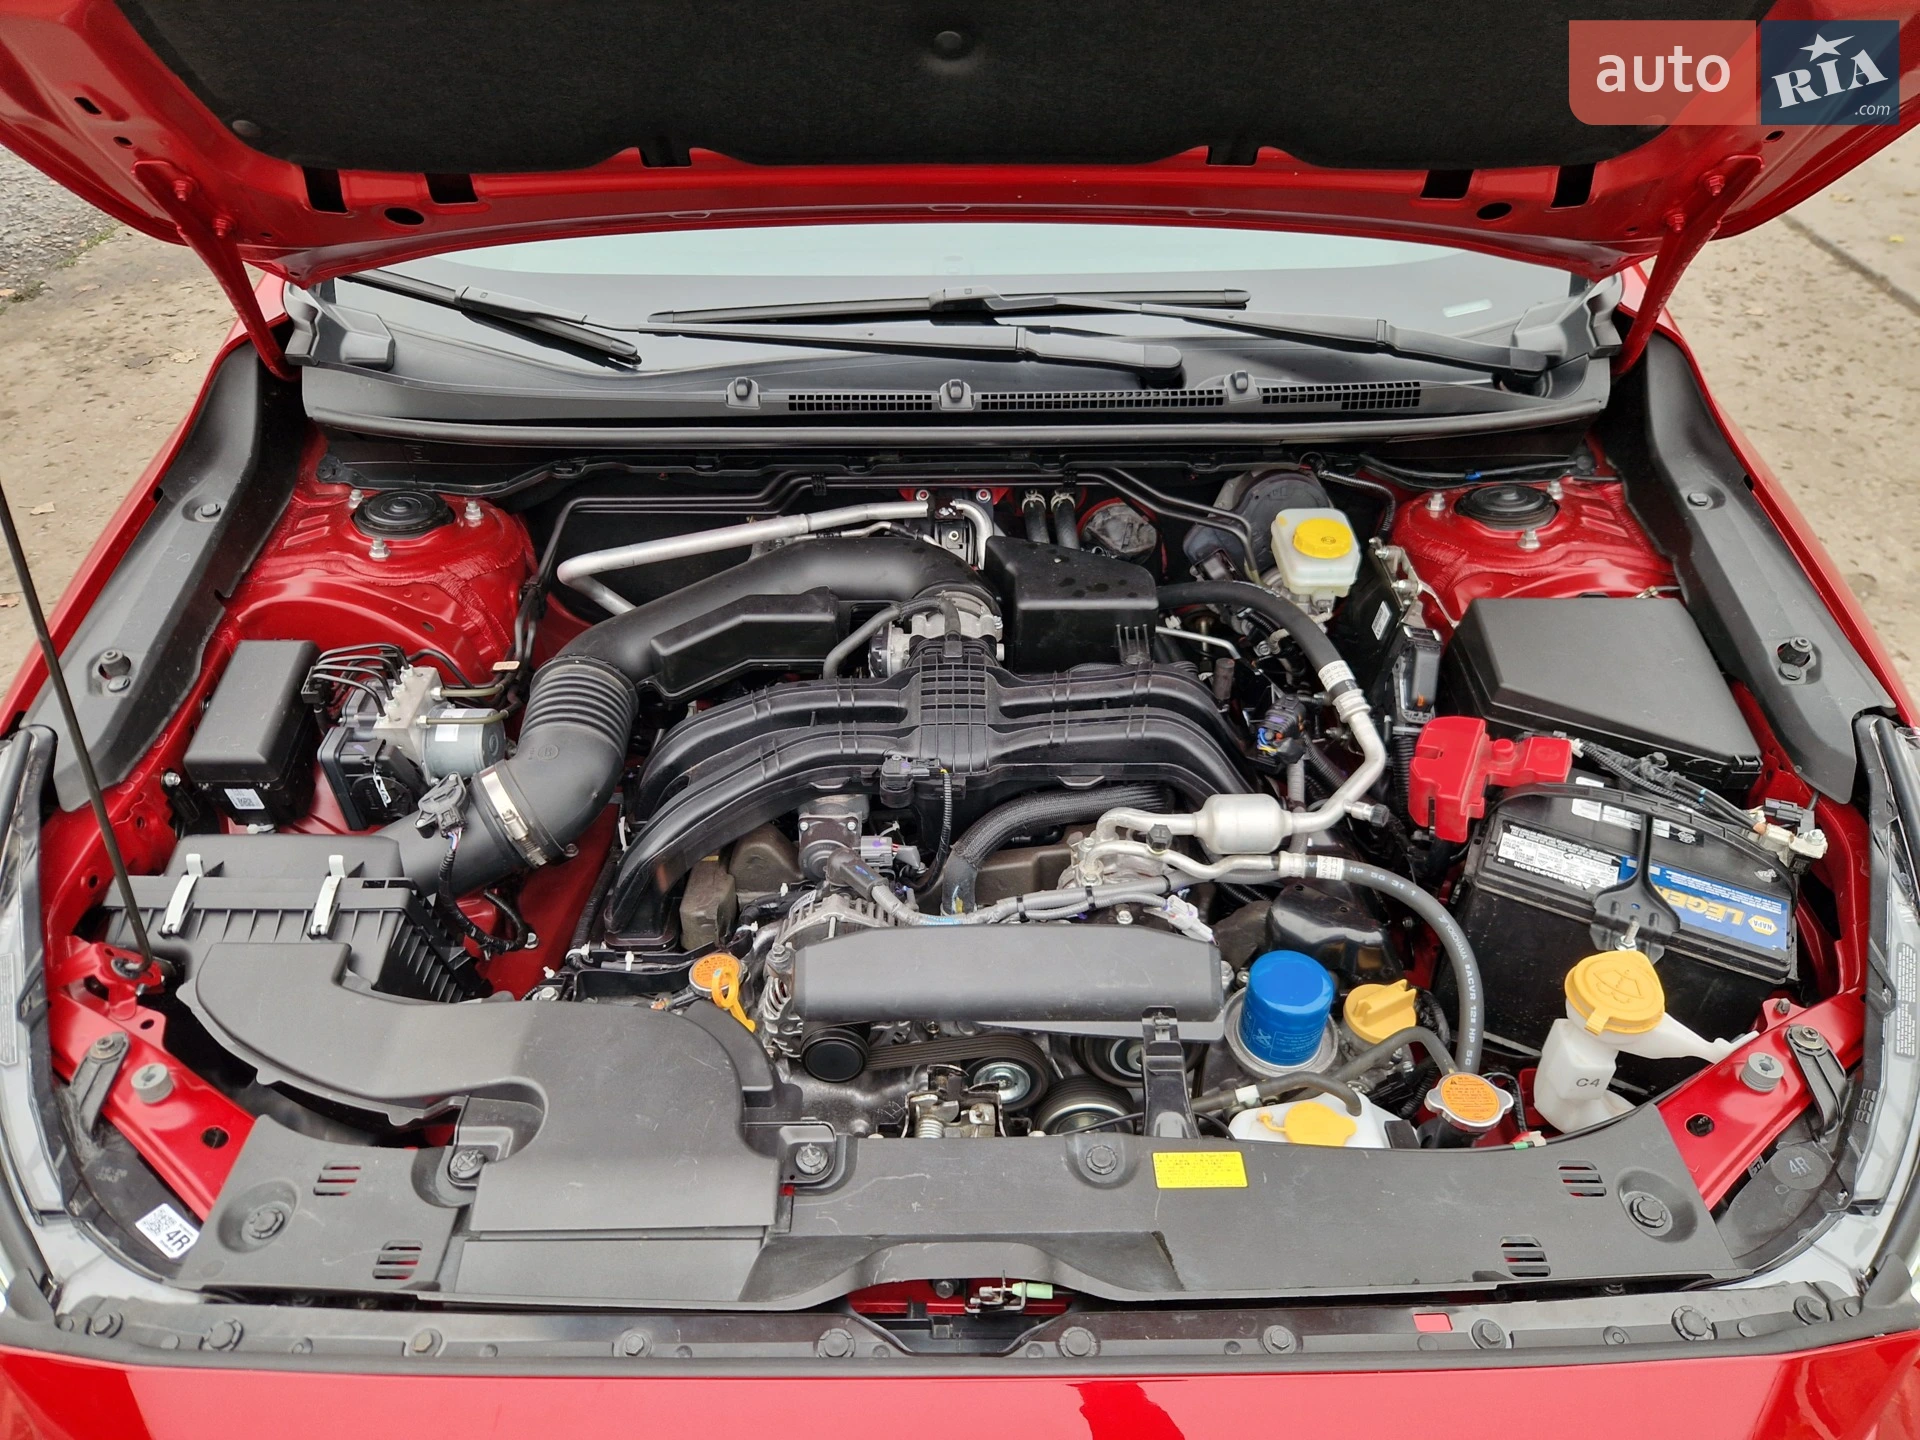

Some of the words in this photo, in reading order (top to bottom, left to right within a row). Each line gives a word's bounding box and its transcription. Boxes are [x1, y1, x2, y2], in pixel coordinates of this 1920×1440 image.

[1752, 919, 1773, 931] NAPA
[1446, 921, 1468, 960] YOKOHAMA
[1468, 1028, 1477, 1043] HP
[1575, 1077, 1600, 1088] C4
[1789, 1156, 1812, 1176] 4R
[166, 1229, 191, 1252] 4R
